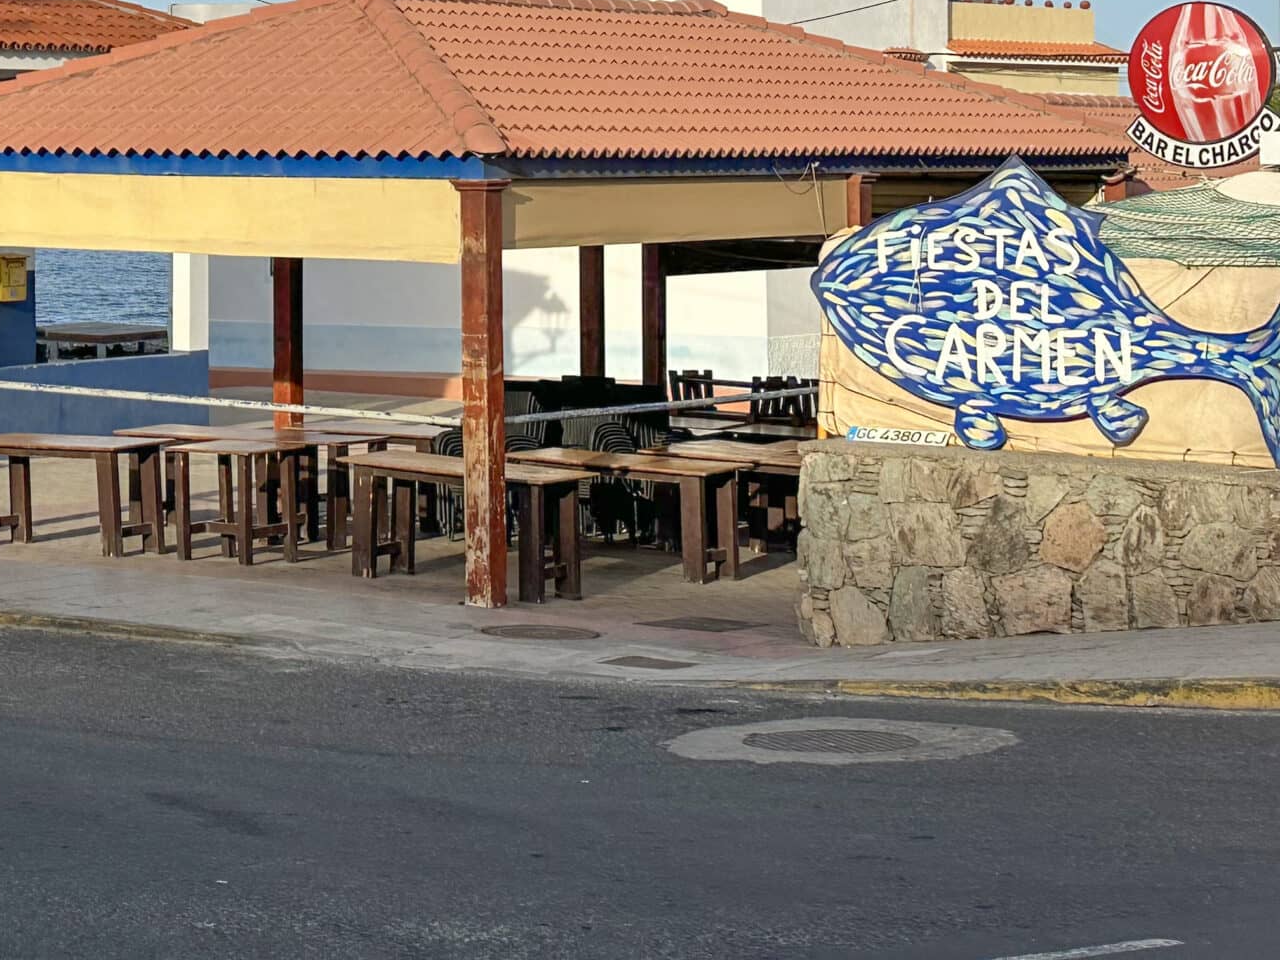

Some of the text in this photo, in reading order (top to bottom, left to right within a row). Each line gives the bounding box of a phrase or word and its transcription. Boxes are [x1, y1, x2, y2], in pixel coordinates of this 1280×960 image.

[1141, 38, 1165, 113] Coca-Cola
[1132, 120, 1168, 158] BAR
[1172, 146, 1195, 166] EL
[972, 280, 1065, 324] DEL
[884, 314, 1132, 386] CARMEN
[856, 427, 948, 445] GC 4380 CJ
